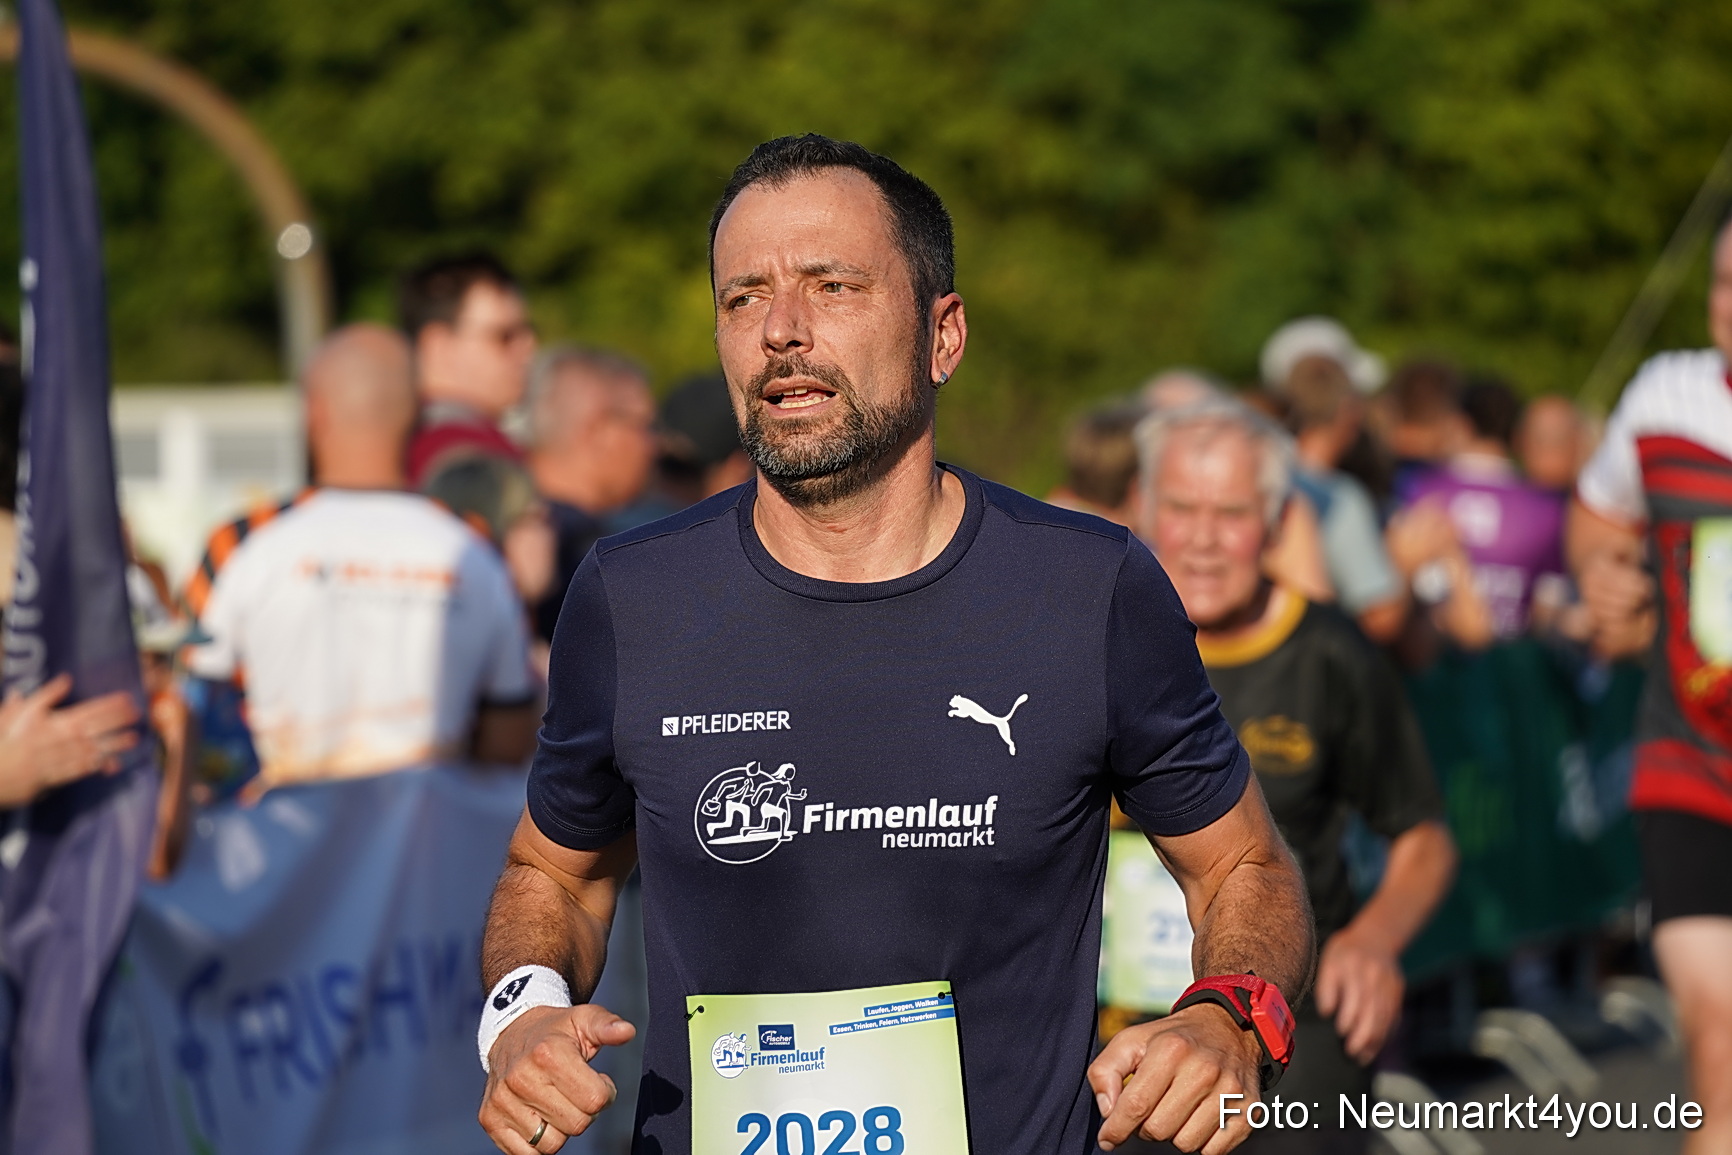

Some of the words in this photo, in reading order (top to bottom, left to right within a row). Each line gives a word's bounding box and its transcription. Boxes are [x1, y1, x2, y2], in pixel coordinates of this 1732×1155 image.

[681, 710, 792, 735] PFLEIDERER
[802, 794, 999, 833] Firmenlauf
[881, 826, 996, 849] neumarkt
[867, 1005, 891, 1017] Laufen,
[891, 1002, 915, 1013] Joggen,
[915, 998, 939, 1009] Walken
[832, 1025, 854, 1035] Essen,
[854, 1021, 879, 1032] Trinken,
[879, 1018, 900, 1029] Feiern,
[900, 1011, 937, 1024] Netzwerken
[765, 1034, 793, 1043] Fischer
[750, 1046, 826, 1067] Firmenlauf
[778, 1060, 826, 1074] neumarkt
[736, 1105, 905, 1155] 2028
